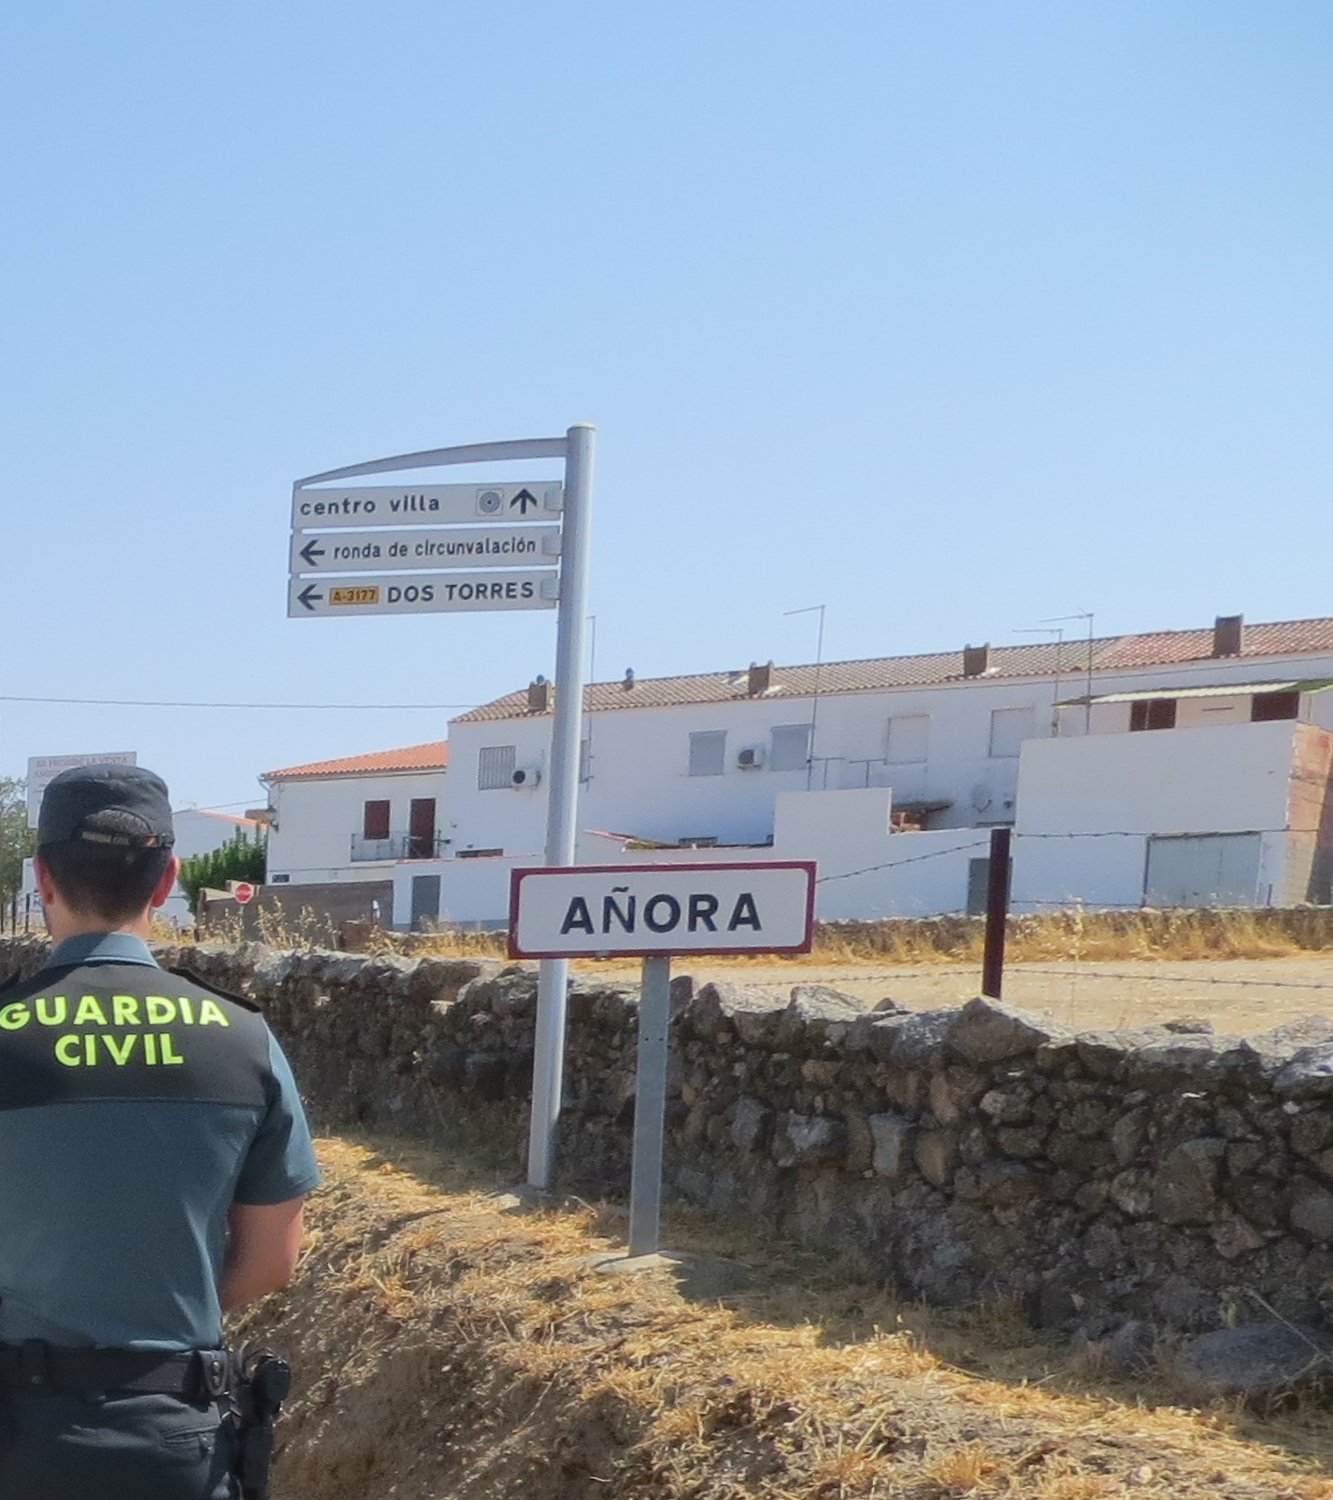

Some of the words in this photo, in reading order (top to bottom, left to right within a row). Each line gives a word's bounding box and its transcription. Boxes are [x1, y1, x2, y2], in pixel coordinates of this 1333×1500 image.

[299, 497, 376, 517] centro
[390, 494, 440, 513] villa
[334, 542, 381, 560] ronda
[388, 541, 408, 558] de
[414, 536, 536, 557] circunvalación
[334, 589, 376, 603] A-3177
[387, 585, 433, 604] DOS
[445, 581, 534, 601] TORRES
[560, 886, 763, 935] AÑORA
[53, 1032, 185, 1067] CIVIL
